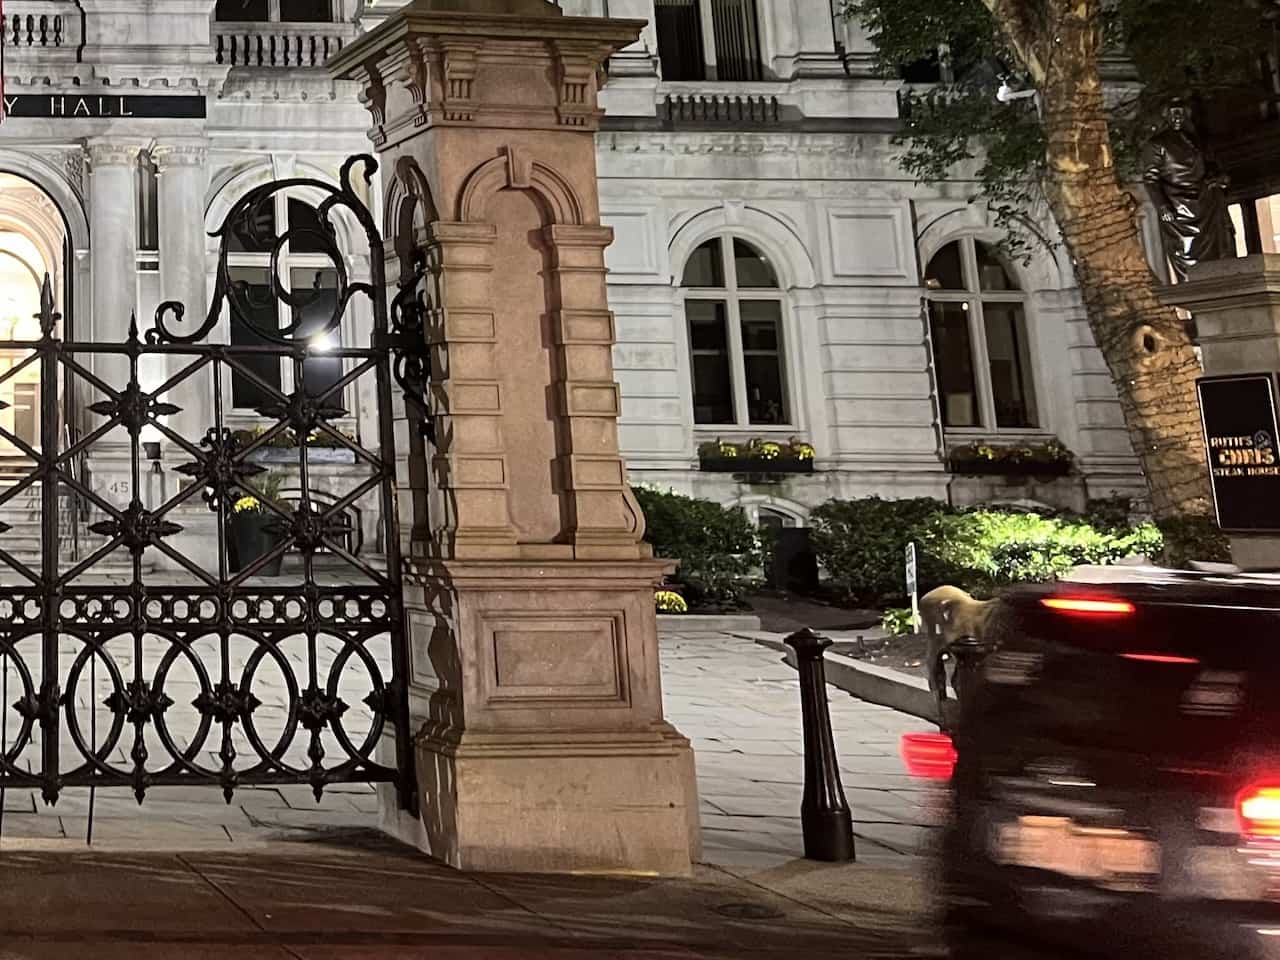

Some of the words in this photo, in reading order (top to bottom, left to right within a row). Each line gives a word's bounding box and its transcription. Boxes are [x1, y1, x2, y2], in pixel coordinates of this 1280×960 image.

[50, 95, 133, 116] HALL
[1219, 448, 1275, 465] CHRIS
[110, 481, 129, 494] 45
